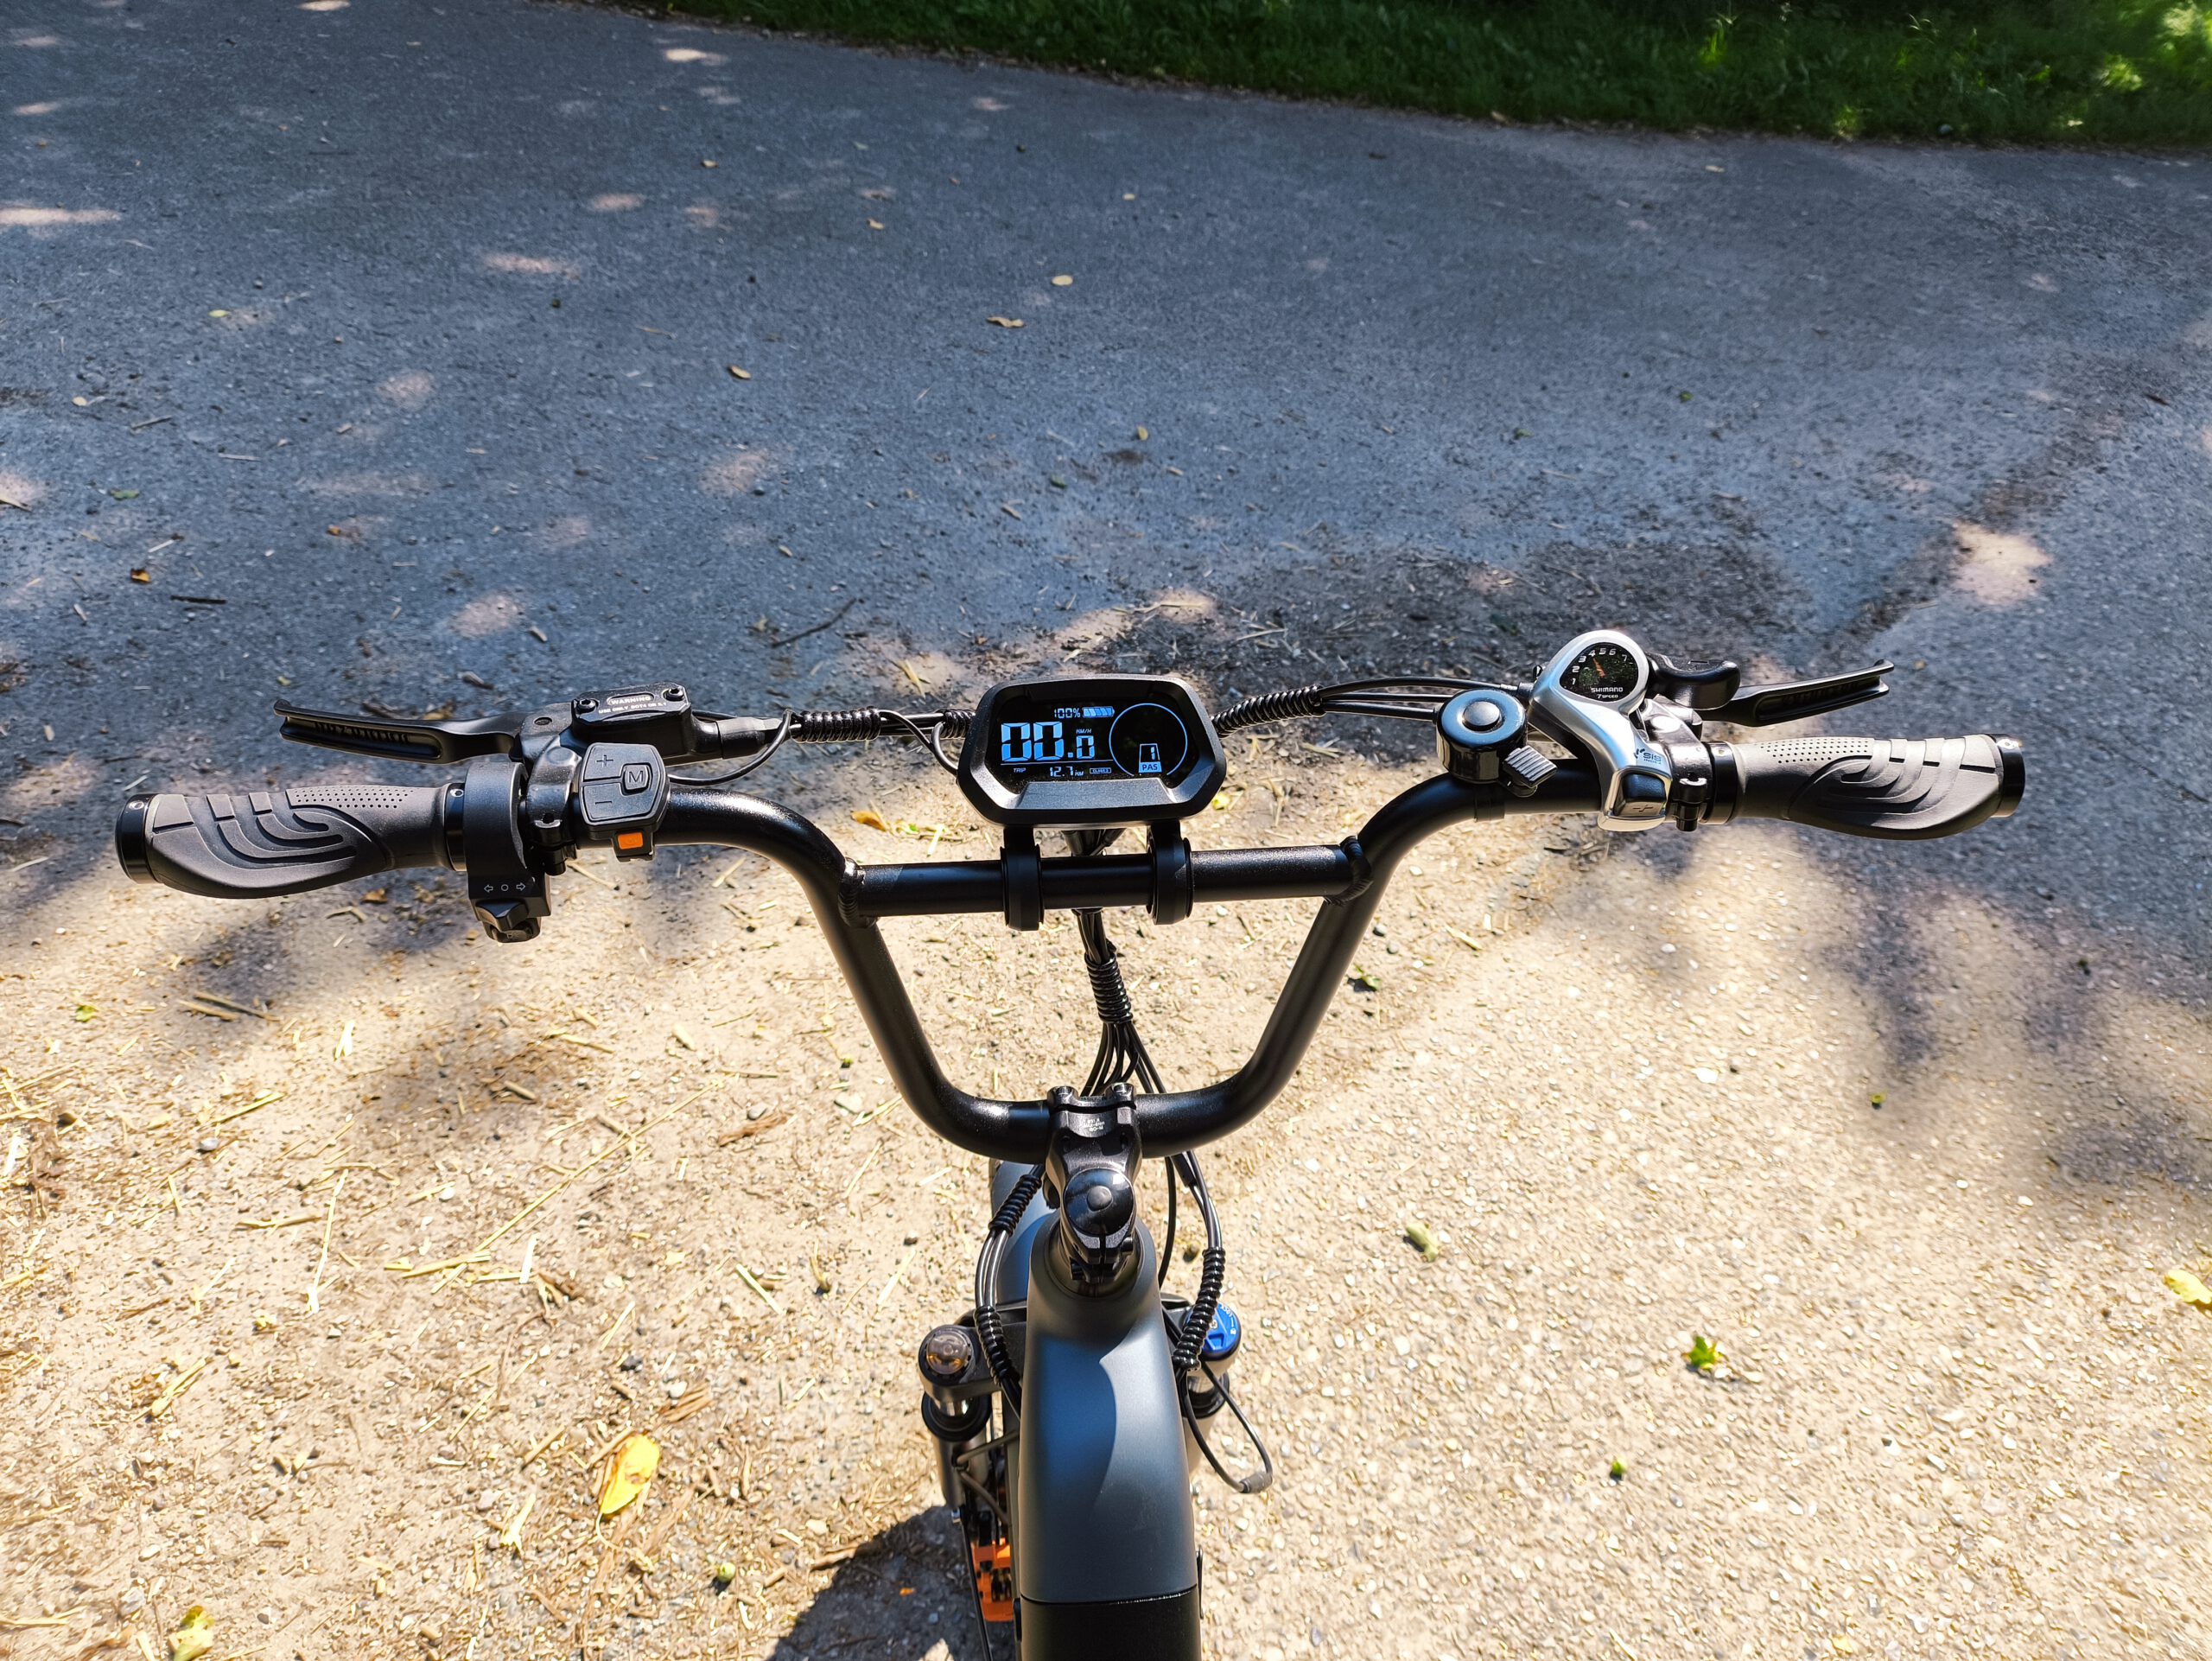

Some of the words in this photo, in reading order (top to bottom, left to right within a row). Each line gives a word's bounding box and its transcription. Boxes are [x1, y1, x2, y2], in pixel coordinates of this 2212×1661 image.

[1621, 653, 1628, 662] 7
[611, 696, 652, 705] WARNING
[1053, 707, 1081, 719] 100%
[628, 770, 644, 783] M
[1049, 766, 1074, 777] 12.7
